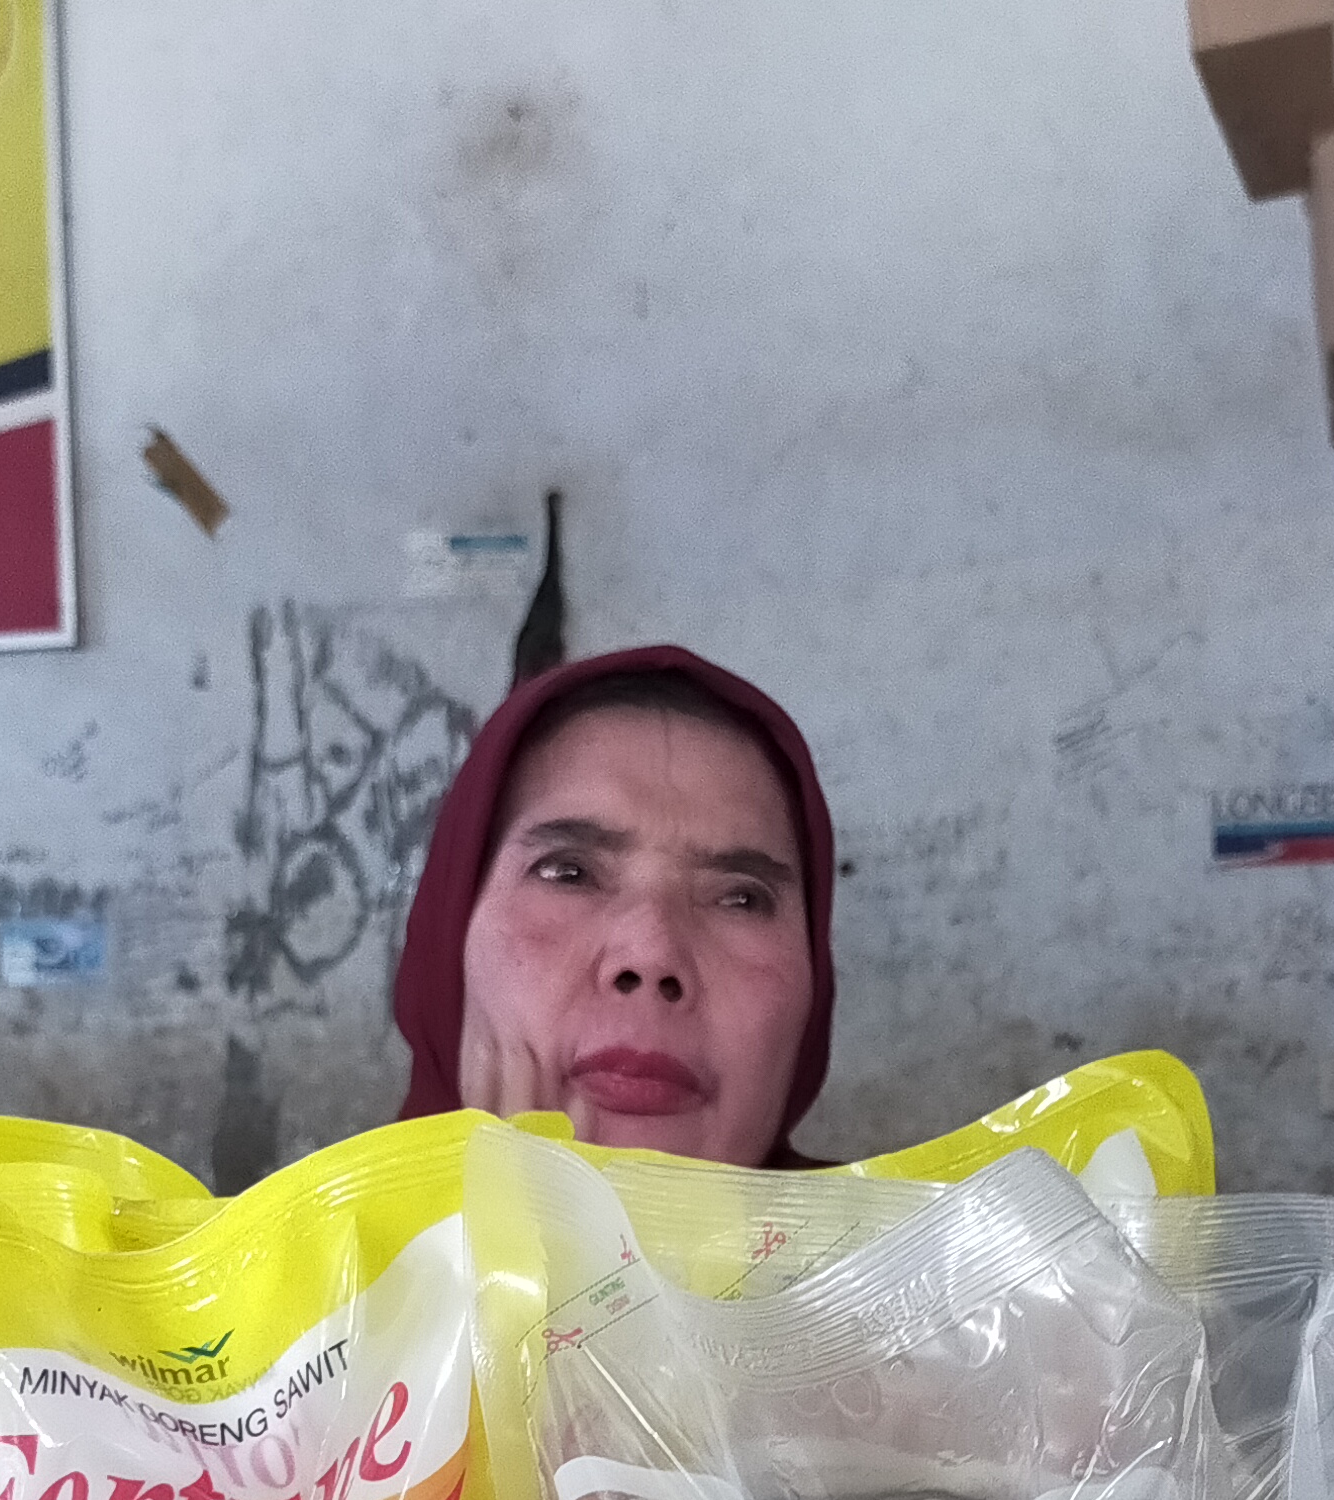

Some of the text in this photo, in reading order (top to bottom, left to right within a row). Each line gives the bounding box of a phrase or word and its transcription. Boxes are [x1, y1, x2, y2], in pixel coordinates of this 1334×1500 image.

[18, 1366, 135, 1414] MINYAK
[137, 1406, 270, 1447] GORENG
[273, 1338, 350, 1420] SAWIT
[108, 1350, 231, 1387] wilmar
